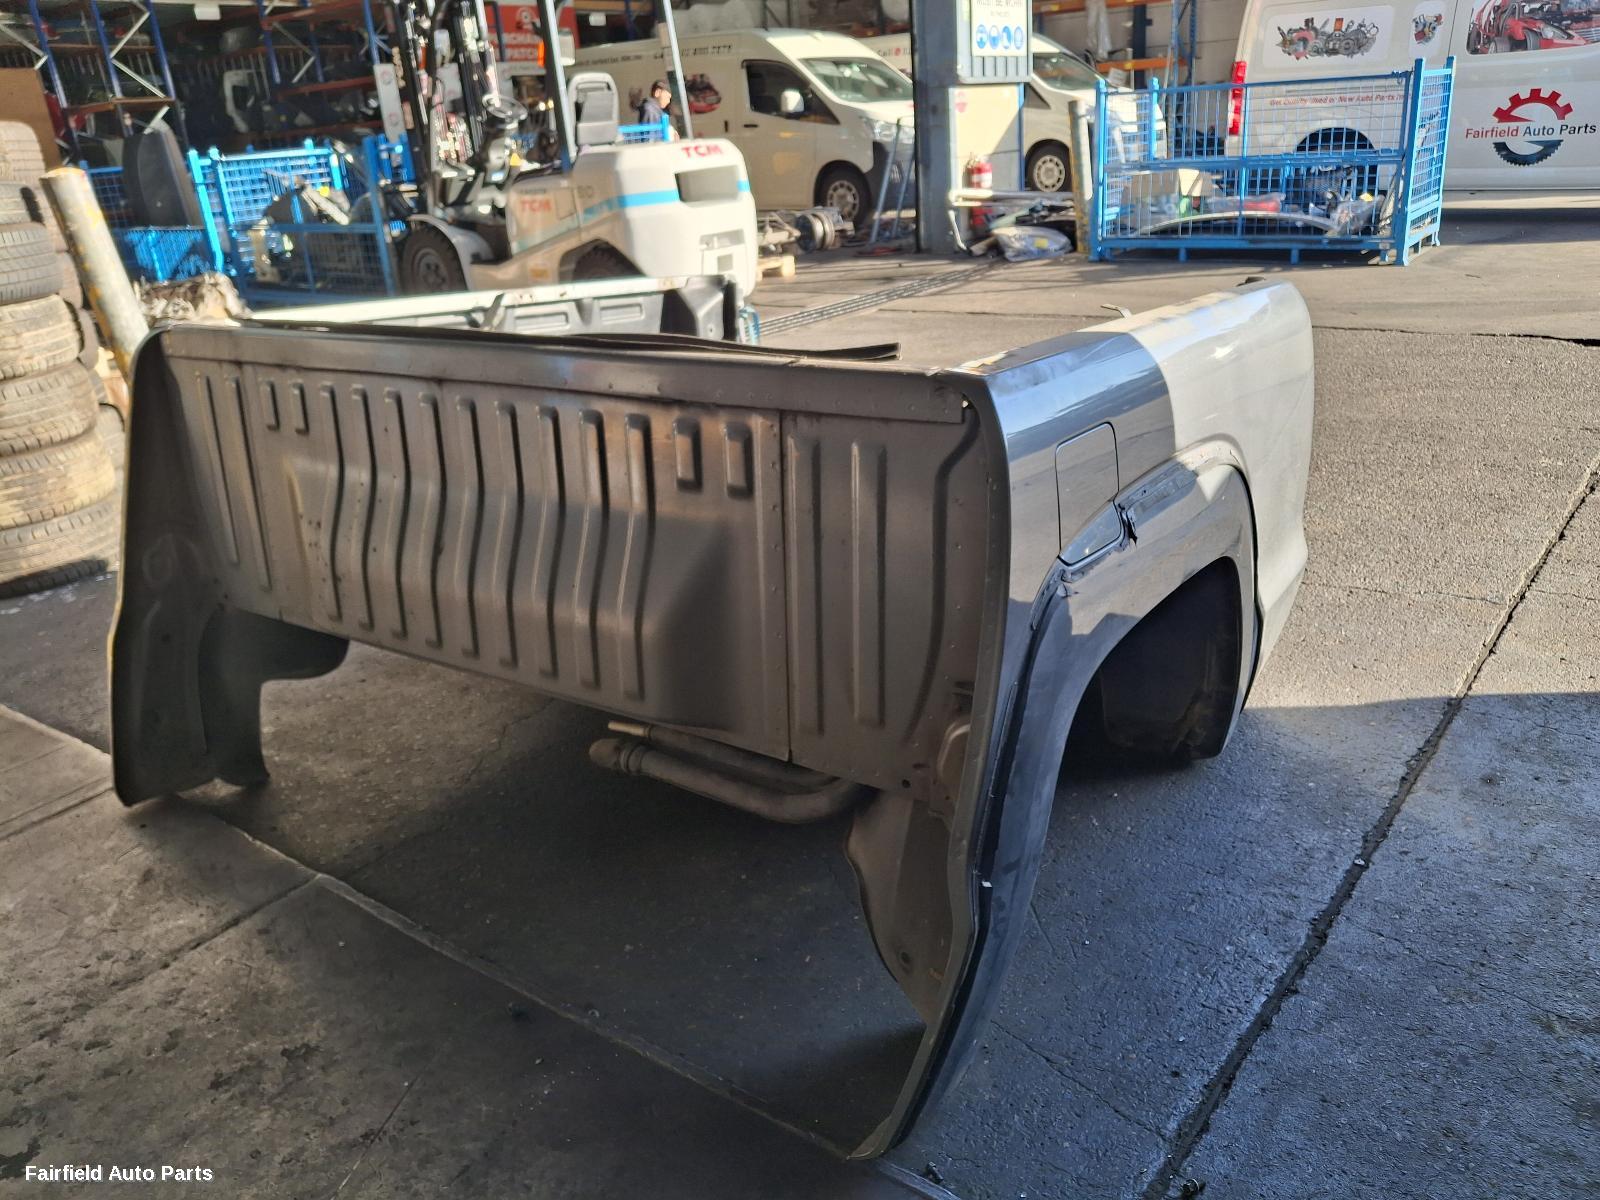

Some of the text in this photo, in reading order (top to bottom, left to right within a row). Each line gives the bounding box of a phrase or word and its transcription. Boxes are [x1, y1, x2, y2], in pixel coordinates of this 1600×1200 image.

[1465, 123, 1597, 139] Fairfield Auto Parts
[681, 145, 723, 159] TCM
[521, 199, 552, 214] TCM
